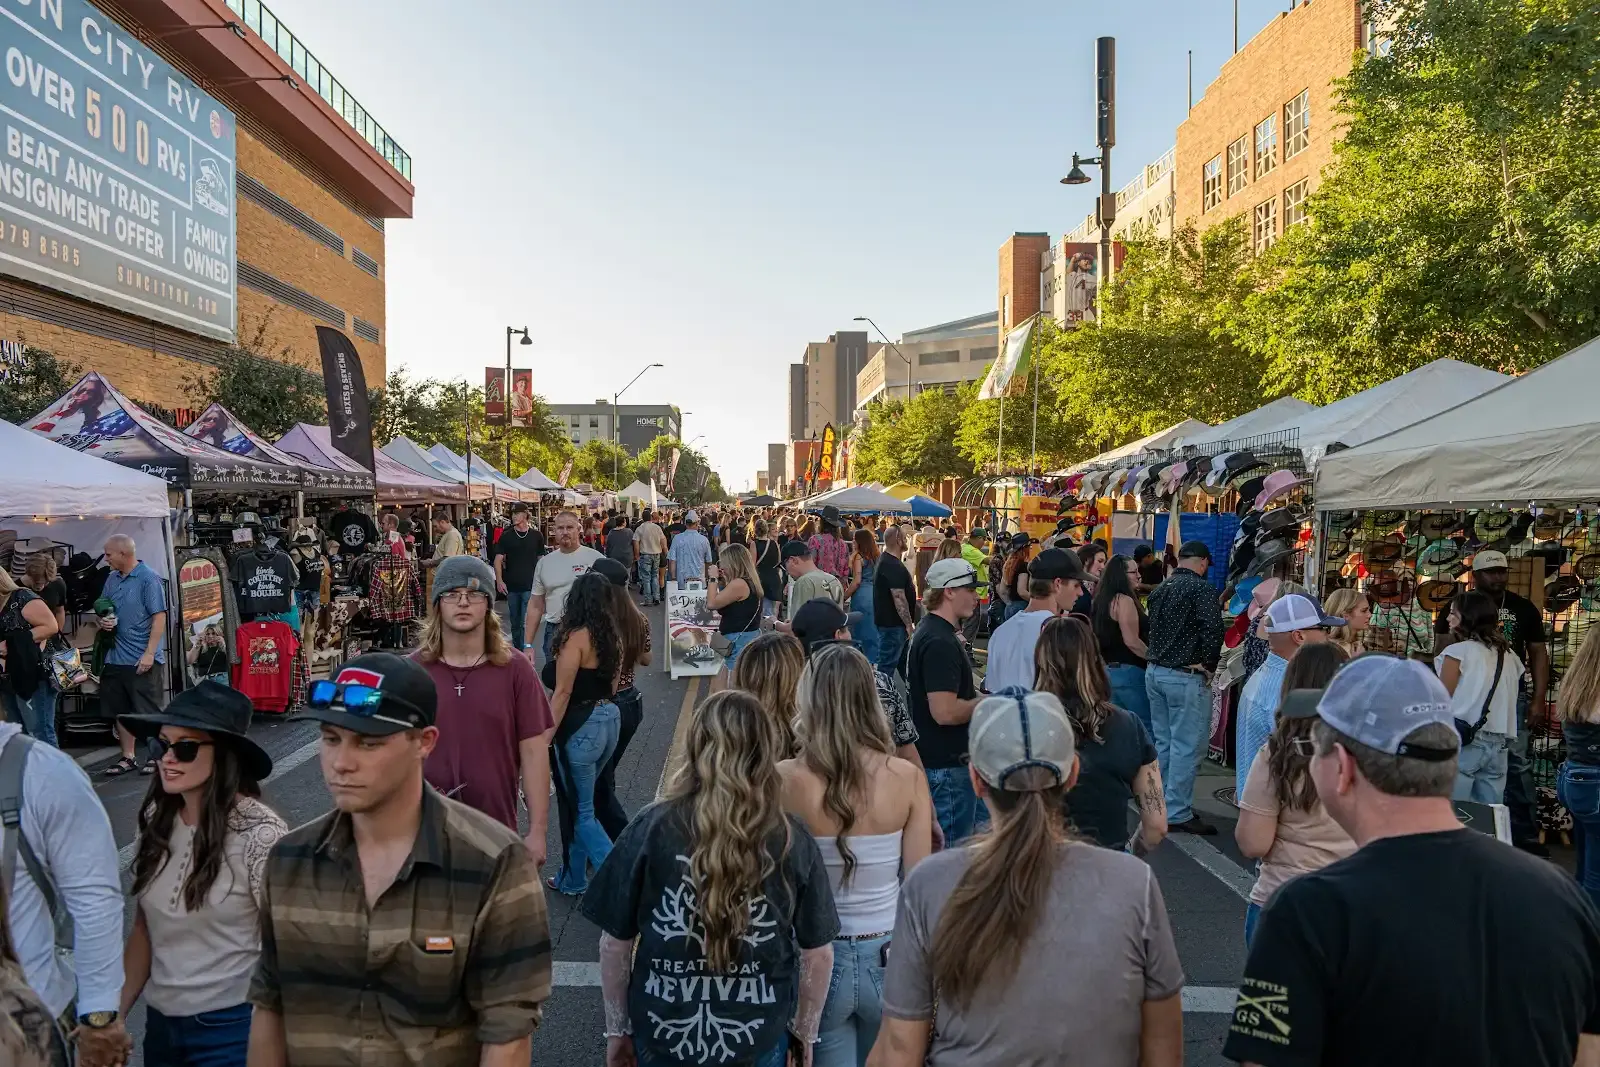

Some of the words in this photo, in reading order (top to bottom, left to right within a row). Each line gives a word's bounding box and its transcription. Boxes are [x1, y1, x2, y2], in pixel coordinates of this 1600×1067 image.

[81, 16, 155, 90] CITY
[167, 76, 200, 122] RV
[6, 46, 76, 119] OVER
[86, 87, 149, 166] 500
[157, 137, 186, 182] RVs
[7, 125, 60, 177] BEAT
[65, 157, 104, 198] ANY
[108, 177, 160, 227] TRADE
[39, 236, 80, 267] 8585
[114, 215, 164, 259] OFFER
[185, 217, 228, 257] FAMILY
[183, 246, 229, 285] OWNED
[337, 352, 348, 384] SEVENS
[343, 391, 352, 415] SIXES
[821, 427, 835, 471] BBQ
[247, 574, 284, 587] COUNTRY
[651, 958, 709, 974] TREAT
[644, 969, 777, 1004] REVIVAL
[1236, 1009, 1261, 1027] GS
